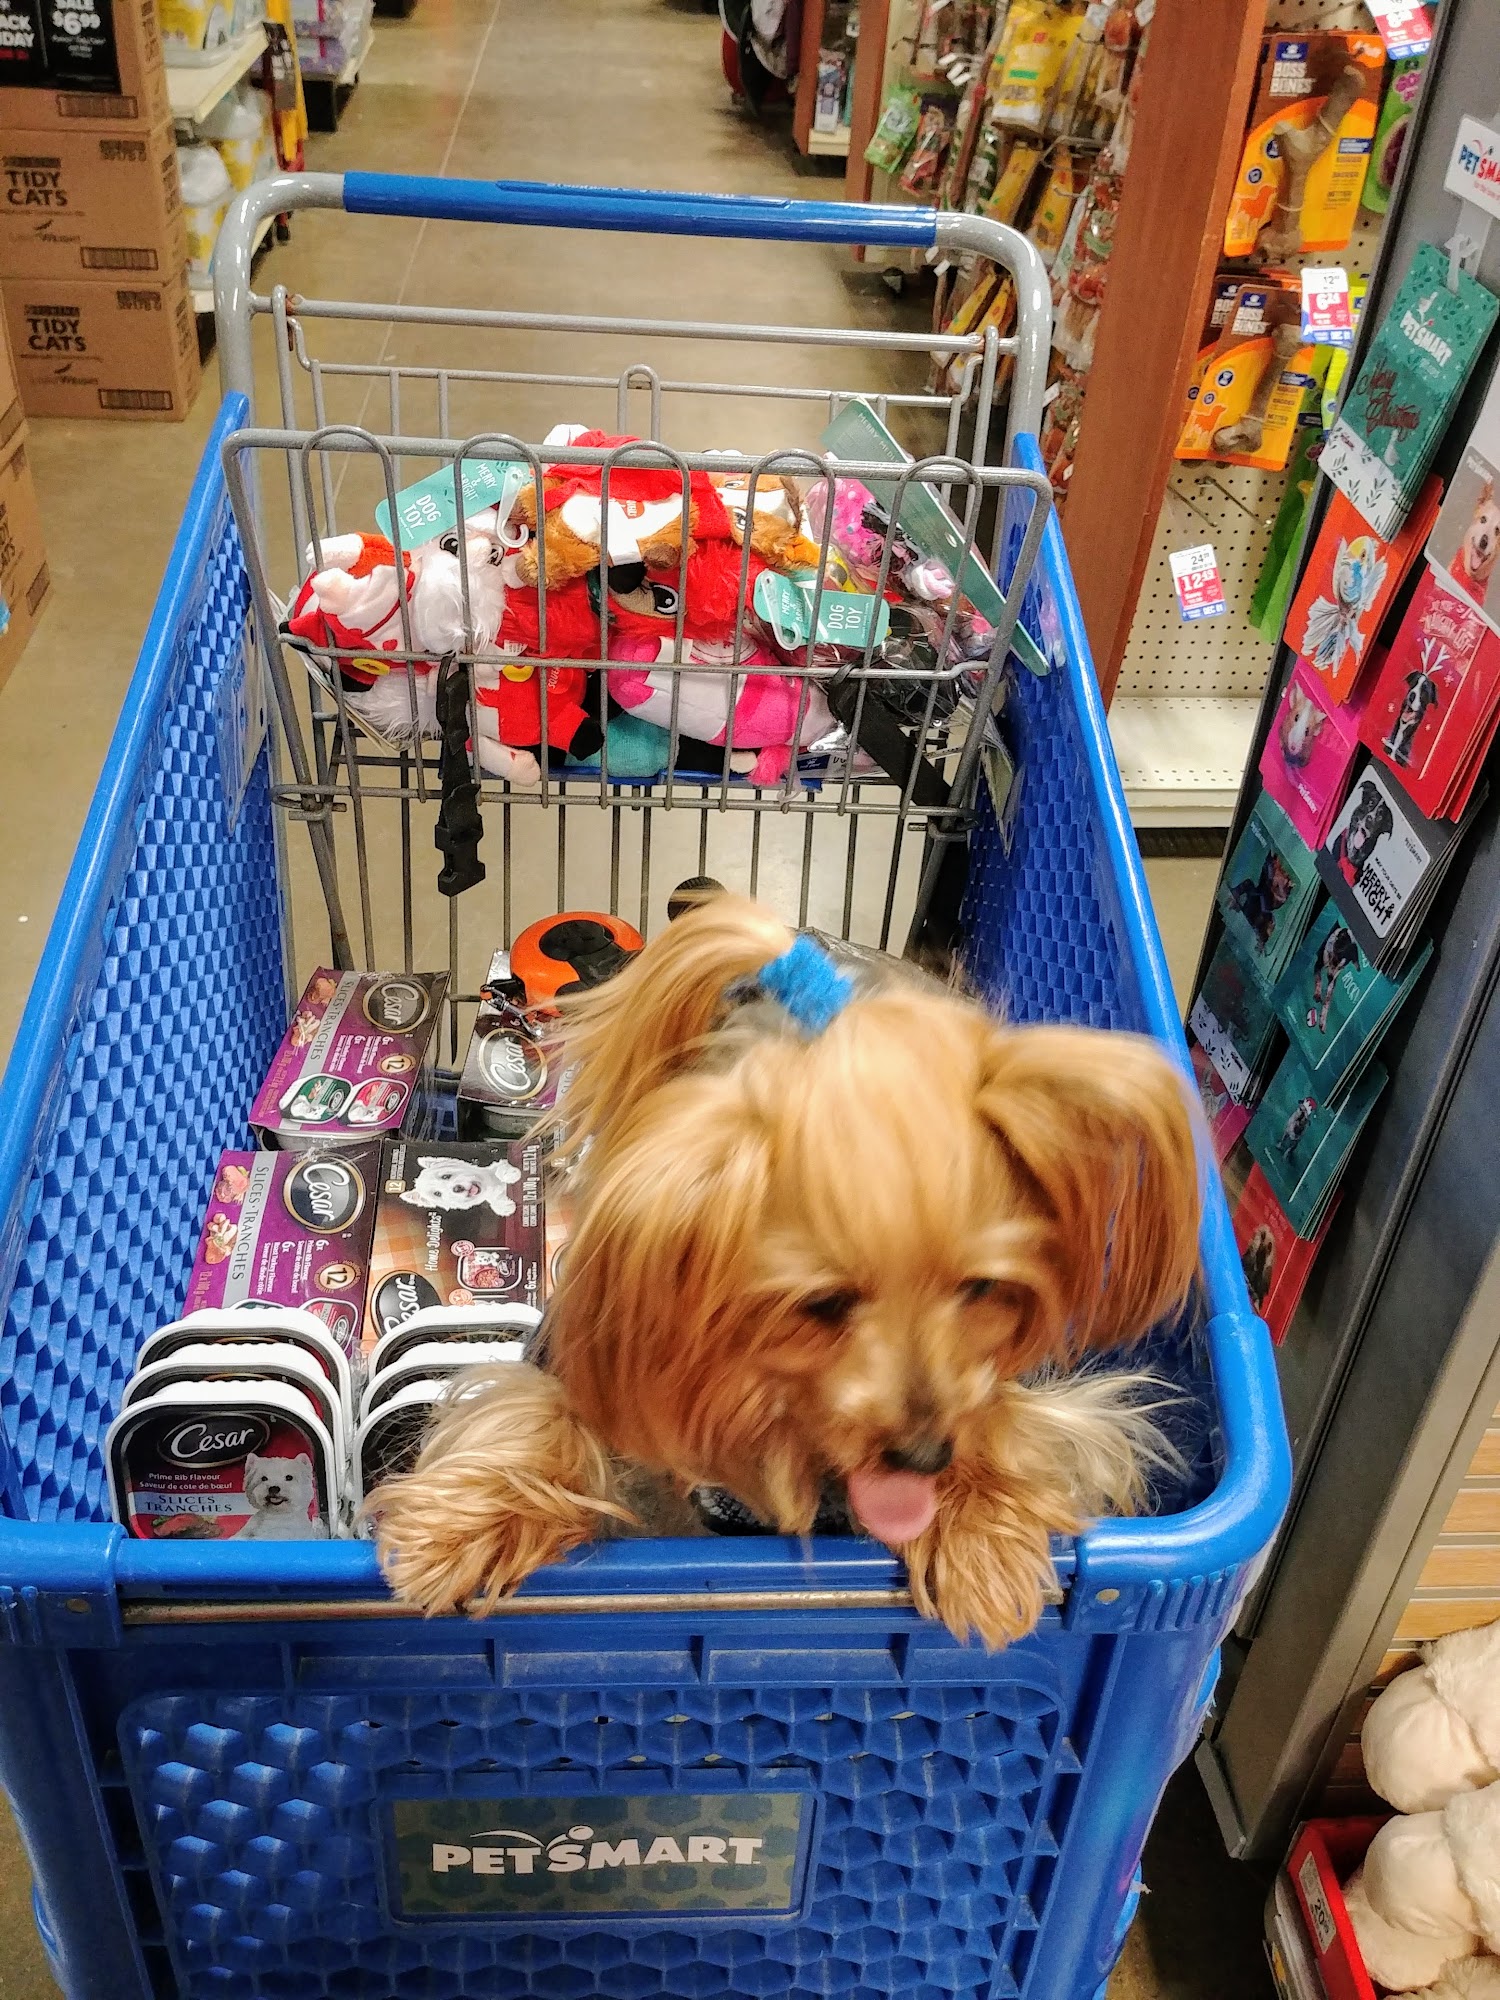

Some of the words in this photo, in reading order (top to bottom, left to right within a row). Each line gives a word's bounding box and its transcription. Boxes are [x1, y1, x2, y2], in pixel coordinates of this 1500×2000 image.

[5, 170, 61, 188] TIDY
[7, 188, 68, 207] CATS
[26, 318, 80, 335] TIDY
[1400, 310, 1452, 367] PETSMART
[27, 335, 87, 352] CATS
[858, 412, 880, 440] MERRY
[471, 478, 481, 487] &
[476, 463, 498, 489] MERRY
[403, 504, 426, 530] TOY
[416, 494, 442, 523] DOG
[781, 589, 790, 615] MERRY
[827, 604, 845, 630] DOG
[845, 606, 863, 630] TOY
[1362, 863, 1391, 904] MERRY
[1359, 876, 1393, 926] RIGHT
[333, 980, 354, 1008] SLICES
[381, 983, 419, 1026] Cesar
[309, 1009, 341, 1061] TRANCHES
[387, 1058, 405, 1070] 12
[489, 1036, 529, 1092] Cesar
[247, 1165, 270, 1205] SLICES
[303, 1163, 351, 1222] Cesar
[388, 1181, 403, 1192] 12
[231, 1206, 260, 1281] TRANCHES
[426, 1214, 444, 1248] Delights
[281, 1240, 296, 1253] 6x
[315, 1239, 330, 1251] 6x
[425, 1249, 439, 1271] Home
[326, 1267, 348, 1285] 12
[171, 1423, 255, 1459] Cesar
[139, 1481, 166, 1489] Saveur
[167, 1481, 178, 1490] de
[198, 1482, 209, 1490] de
[149, 1472, 173, 1481] Prime
[175, 1472, 188, 1481] Rib
[190, 1473, 221, 1482] Flavour
[145, 1502, 232, 1513] TRANCHES
[158, 1494, 216, 1504] SLICES
[432, 1835, 763, 1874] PETSMART
